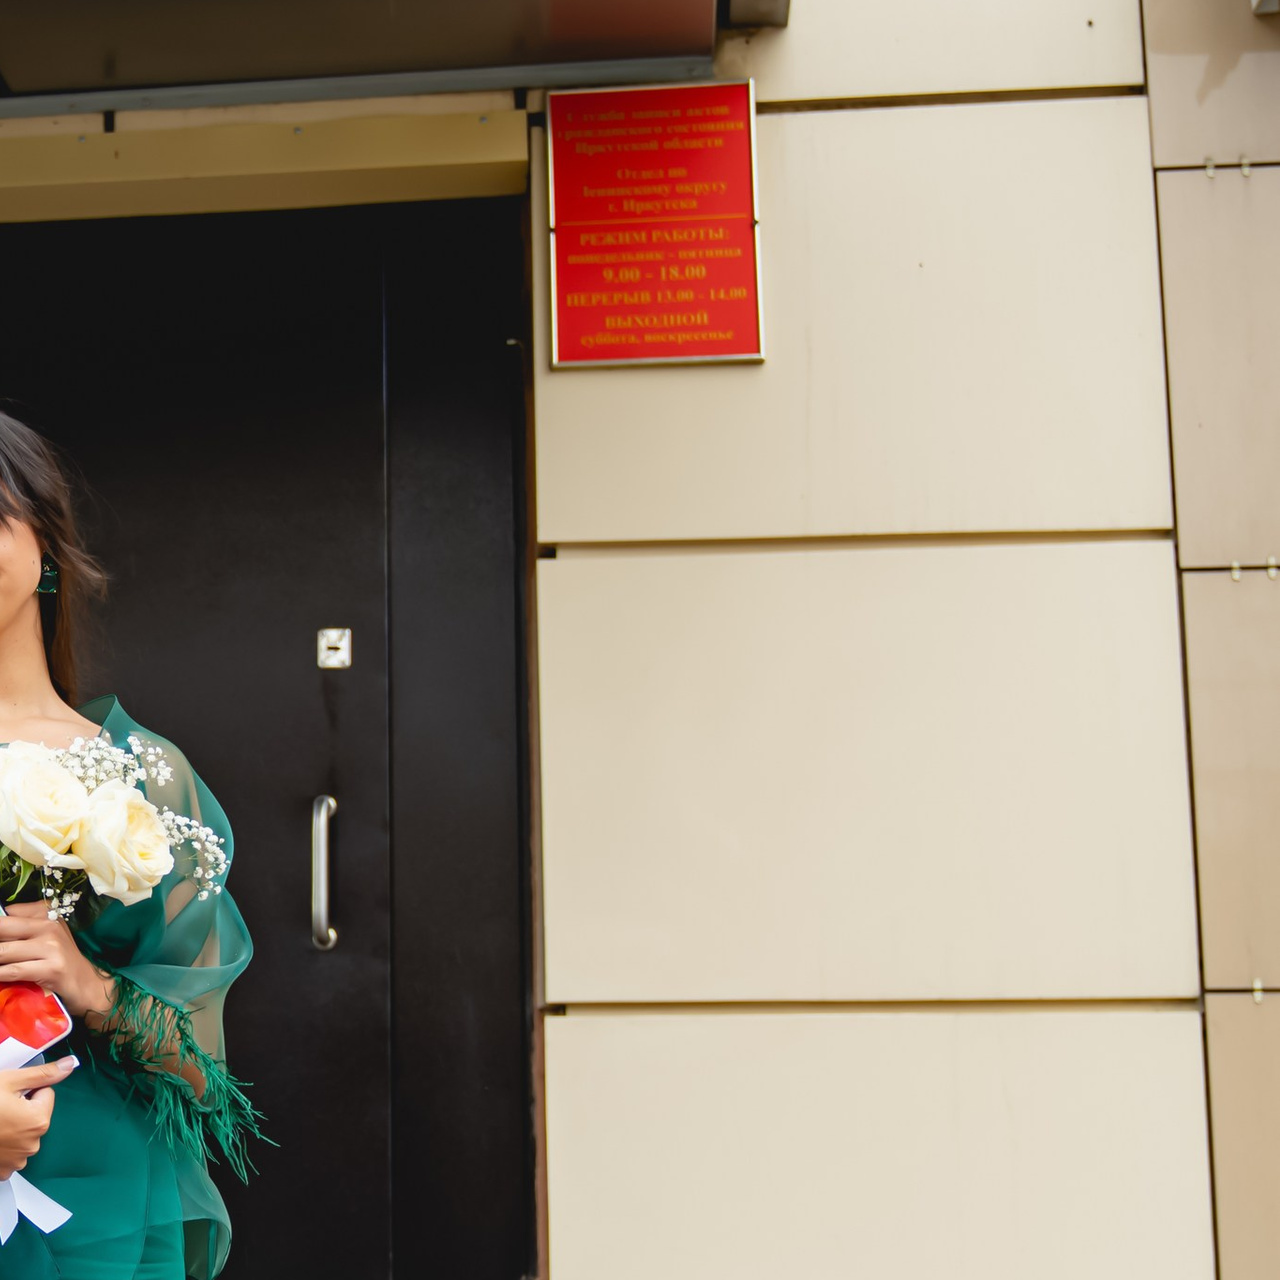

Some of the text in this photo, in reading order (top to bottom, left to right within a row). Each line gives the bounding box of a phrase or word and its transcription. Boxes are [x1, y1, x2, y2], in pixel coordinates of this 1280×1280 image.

[580, 230, 647, 246] РЕЖИМ
[603, 267, 640, 283] 9.00
[660, 264, 706, 281] 18.00
[567, 291, 651, 307] ПЕРЕРЫВ
[657, 289, 694, 303] 13.00
[710, 286, 747, 301] 14.00
[605, 310, 709, 329] ВЫХОДНОЙ
